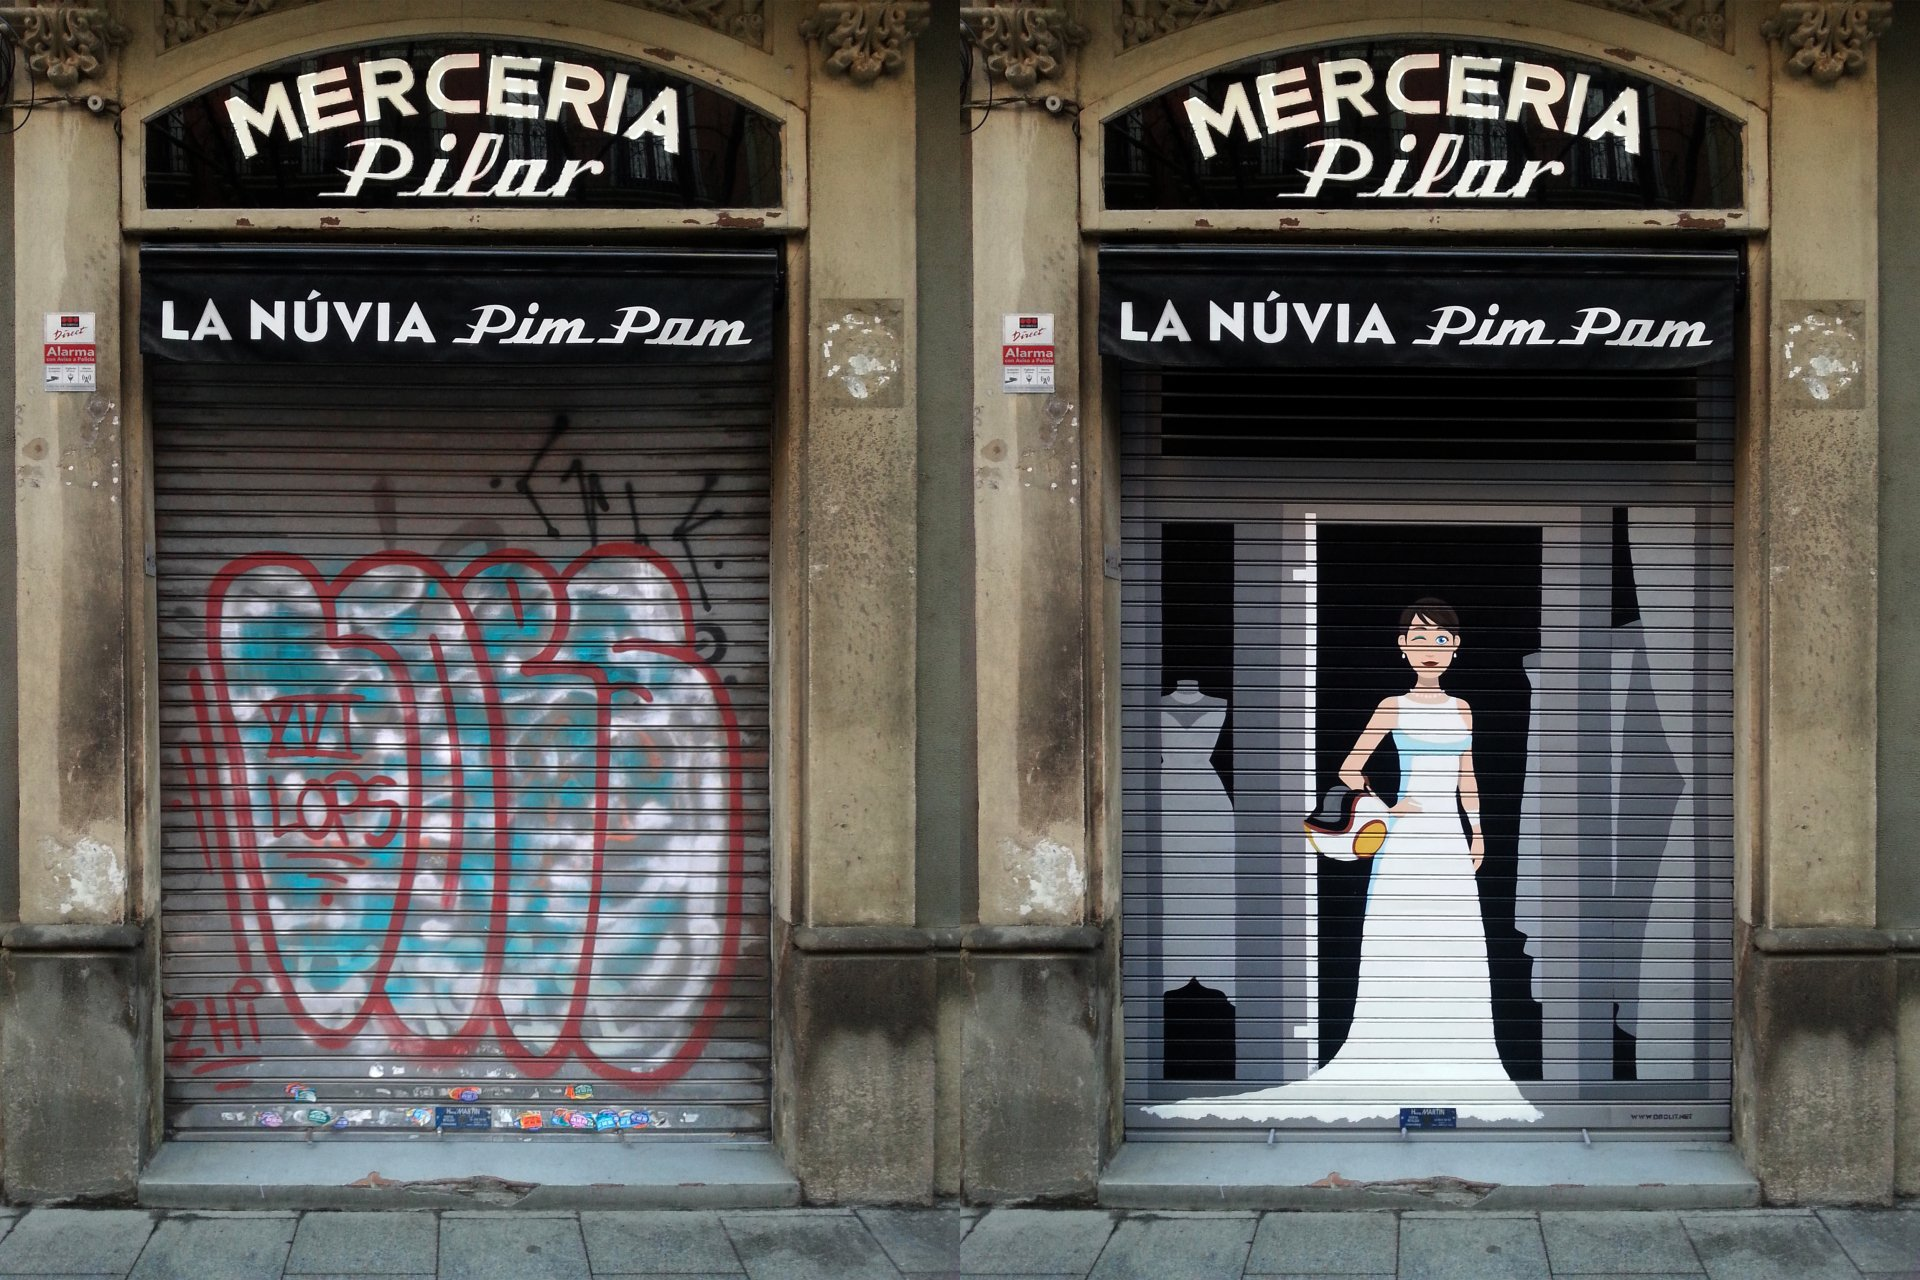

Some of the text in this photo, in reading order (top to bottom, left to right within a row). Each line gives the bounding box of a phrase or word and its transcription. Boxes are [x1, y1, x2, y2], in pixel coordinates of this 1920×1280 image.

[225, 54, 679, 159] MERCERIA
[1184, 54, 1640, 160] MERCERIA
[319, 133, 604, 197] Pilar
[1278, 133, 1564, 198] Pilar
[53, 327, 88, 340] Direct
[162, 289, 752, 347] LA NÚVIA Pim Pam
[1012, 327, 1046, 342] Direct
[1121, 290, 1713, 348] LA NÚVIA Pim Pam
[46, 346, 95, 357] Alarma
[1004, 347, 1054, 358] Alarma
